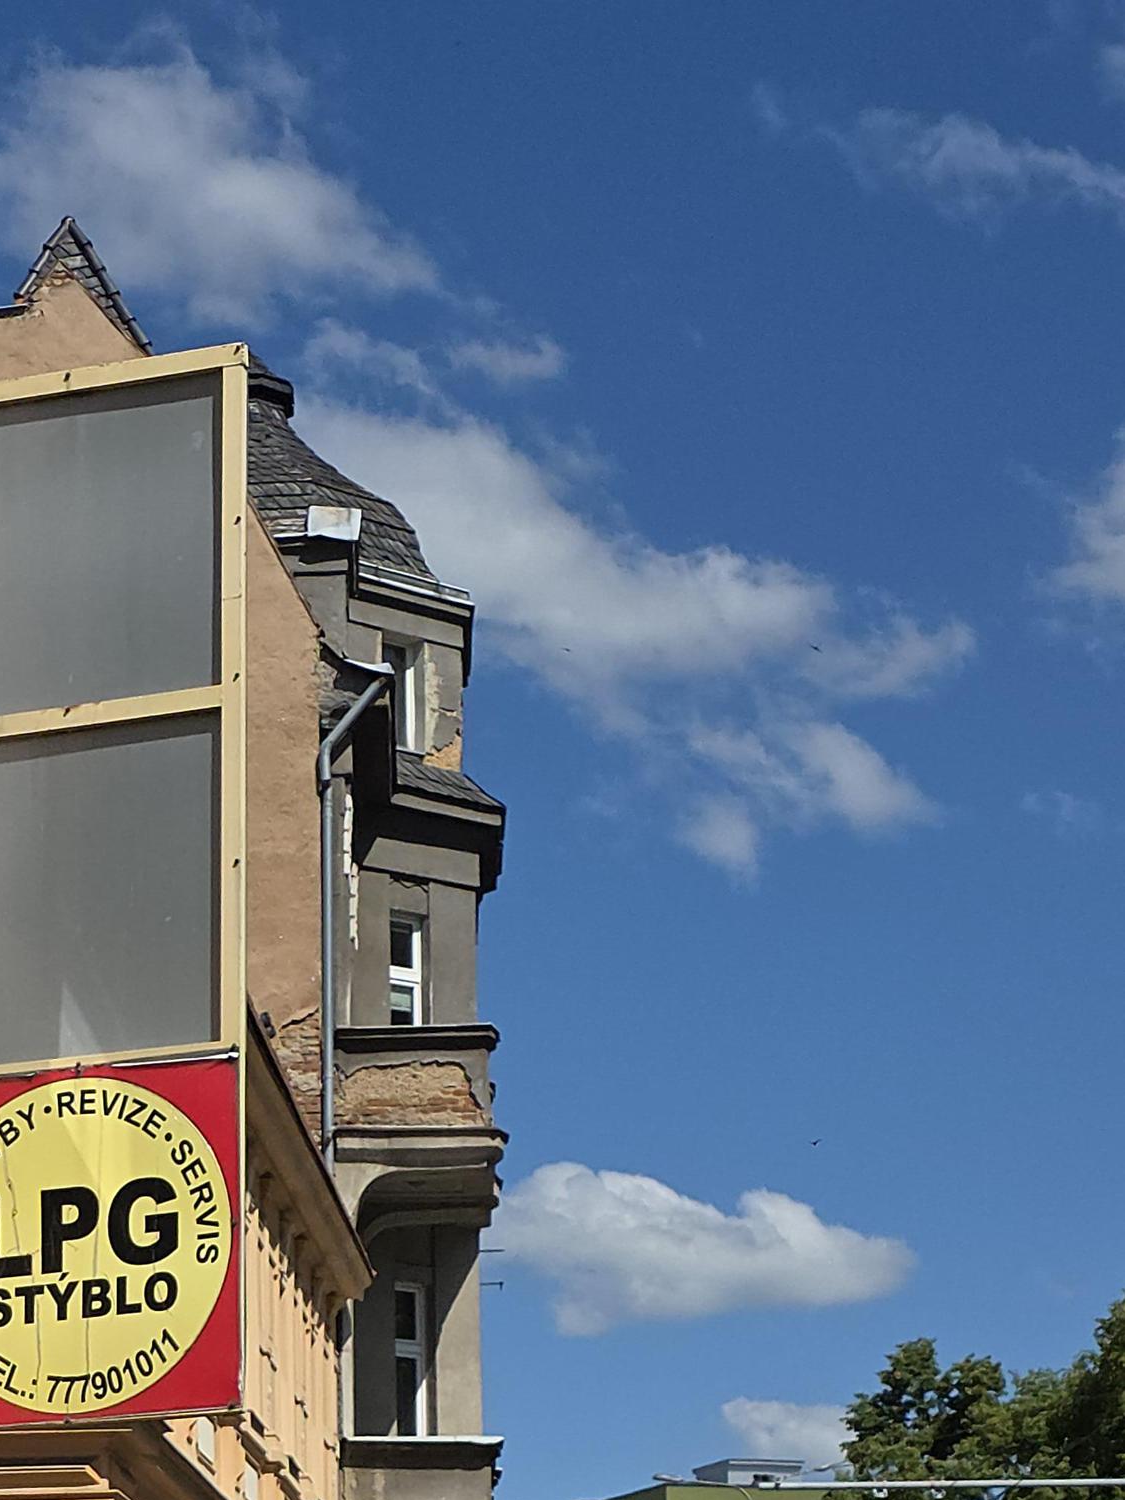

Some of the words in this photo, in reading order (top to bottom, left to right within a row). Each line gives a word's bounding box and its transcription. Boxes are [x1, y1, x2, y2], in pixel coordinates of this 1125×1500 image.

[56, 1089, 167, 1139] REVIZE
[170, 1139, 220, 1264] SERVIS
[46, 1328, 181, 1404] 777901011
